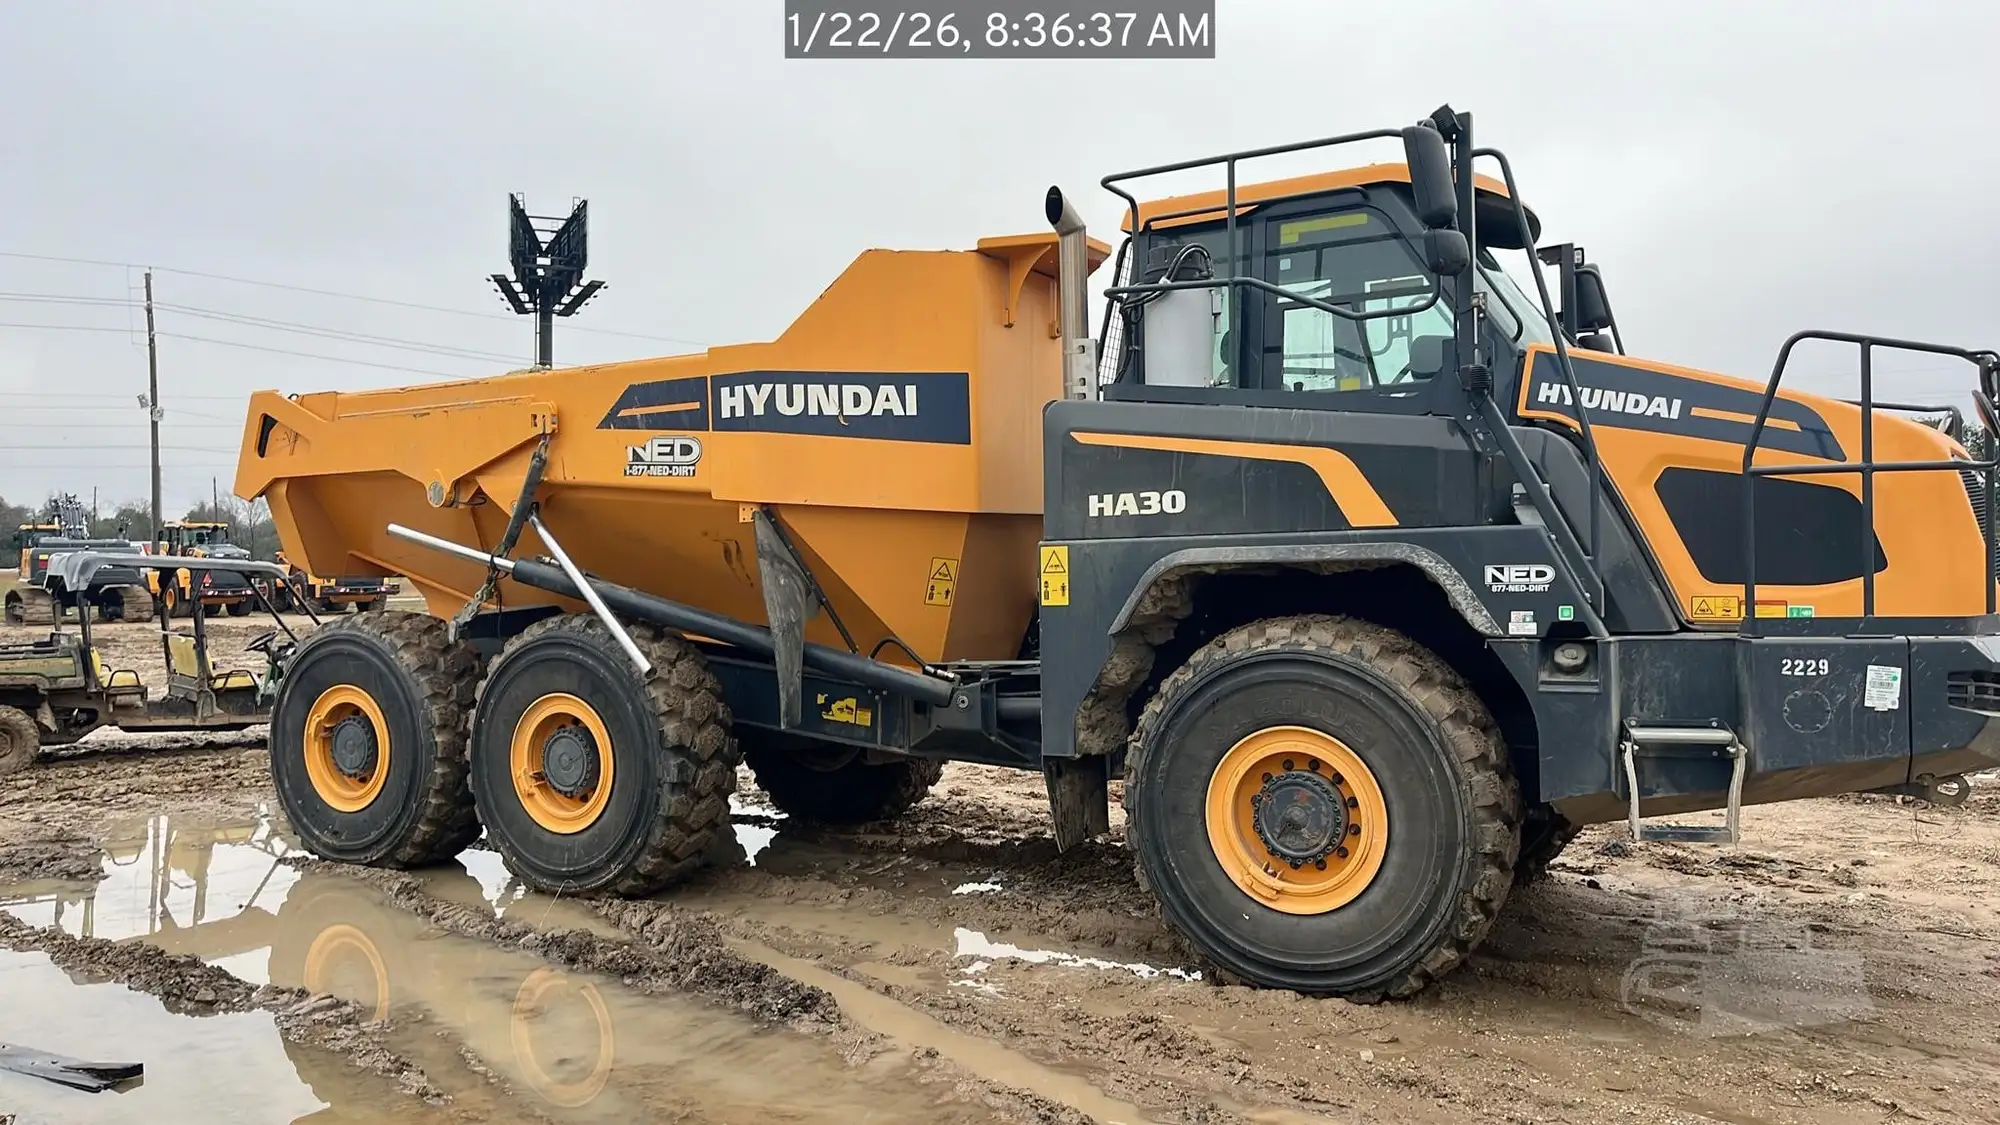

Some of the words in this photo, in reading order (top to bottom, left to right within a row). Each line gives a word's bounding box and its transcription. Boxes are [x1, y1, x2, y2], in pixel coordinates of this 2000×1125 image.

[720, 384, 918, 419] HYUNDAI
[1537, 382, 1682, 420] HYUNDAI
[626, 436, 702, 464] NED
[624, 464, 696, 477] 1-877-NED-DIRT
[1088, 490, 1186, 517] HA30
[1484, 565, 1556, 585] NED
[1781, 658, 1829, 676] 2229
